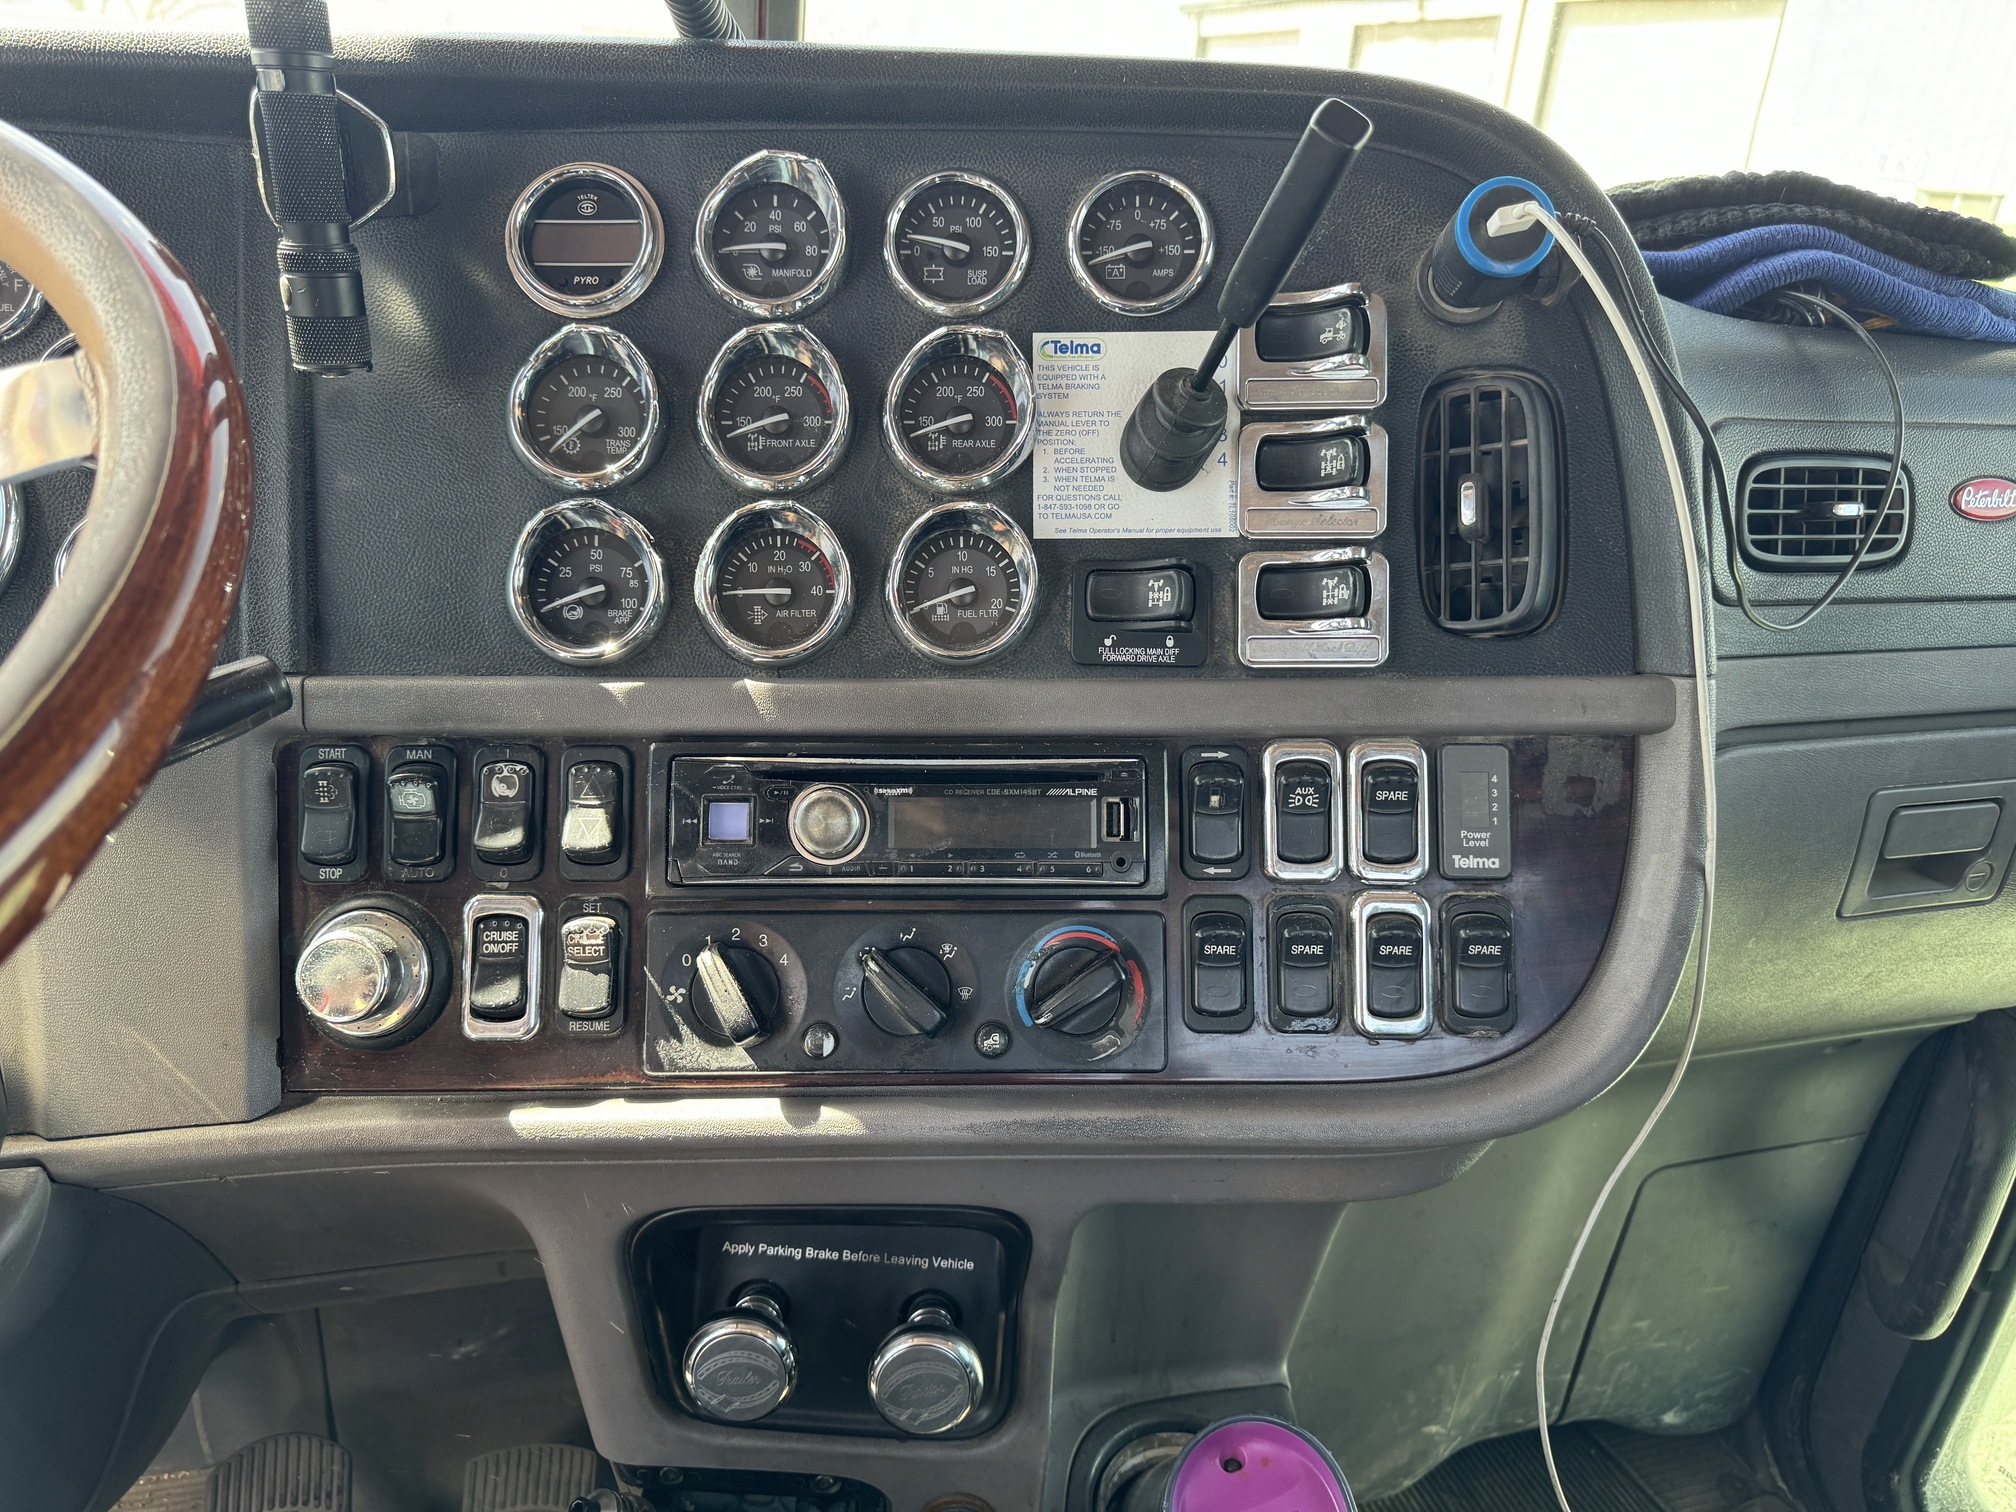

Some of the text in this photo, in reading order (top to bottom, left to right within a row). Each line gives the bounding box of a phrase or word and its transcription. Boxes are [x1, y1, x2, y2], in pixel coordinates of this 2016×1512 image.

[577, 193, 598, 201] TELTEK
[769, 210, 782, 222] 40
[744, 221, 756, 233] 20
[794, 221, 806, 233] 60
[932, 216, 945, 228] 50
[965, 217, 982, 228] 100
[1106, 220, 1122, 231] -75
[1149, 220, 1166, 230] +75
[769, 224, 782, 234] PSI
[950, 225, 962, 233] PSI
[805, 246, 818, 256] 80
[982, 246, 999, 257] 150
[1158, 245, 1181, 256] +150
[772, 268, 812, 278] MANIFOLD
[967, 270, 988, 278] SUSP
[1152, 269, 1174, 278] AMPS
[14, 278, 23, 292] F
[573, 276, 600, 285] PYRO
[967, 277, 988, 285] LOAD
[1050, 340, 1101, 354] Telma
[568, 386, 586, 397] 200
[604, 387, 622, 398] 250
[754, 386, 772, 397] 200
[784, 386, 803, 397] 250
[936, 386, 954, 397] 200
[966, 387, 984, 397] 250
[803, 416, 821, 427] 300
[985, 416, 1002, 427] 300
[617, 427, 636, 438] 300
[606, 439, 631, 448] TRANS
[766, 438, 816, 448] FRONT AXLE
[606, 446, 628, 455] TEMP
[1217, 452, 1228, 467] 4
[1961, 486, 2016, 510] Peterbilt
[590, 550, 603, 560] 50
[774, 551, 786, 561] 20
[957, 551, 968, 561] 10
[590, 564, 603, 572] PSI
[748, 563, 758, 573] 10
[798, 562, 811, 572] 30
[986, 566, 996, 576] 15
[559, 567, 572, 578] 25
[620, 567, 633, 578] 75
[928, 568, 934, 577] 5
[810, 586, 823, 596] 40
[620, 598, 638, 609] 100
[991, 599, 1003, 609] 20
[775, 610, 789, 618] AIR
[318, 748, 346, 759] START
[406, 749, 432, 759] MAN
[1491, 775, 1497, 783] 4
[1375, 790, 1408, 801] SPARE
[1492, 788, 1497, 797] 3
[1492, 803, 1498, 811] 2
[1492, 817, 1497, 825] 1
[1460, 831, 1491, 839] Power
[1463, 839, 1489, 847] Level
[1452, 855, 1499, 869] Telma
[319, 868, 343, 879] STOP
[402, 868, 435, 878] AUTO
[582, 903, 602, 913] SET
[483, 931, 519, 942] CRUISE
[732, 928, 741, 940] 2
[759, 934, 768, 947] 3
[483, 942, 519, 953] ON/OFF
[567, 946, 605, 956] SELECT
[1204, 945, 1236, 955] SPARE
[1291, 945, 1324, 954] SPARE
[1379, 945, 1412, 955] SPARE
[1468, 945, 1501, 955] SPARE
[779, 954, 788, 966] 4
[569, 1021, 610, 1031] RESUME
[722, 1241, 975, 1270] Apply Parking Brake Before Leaving Vehicle
